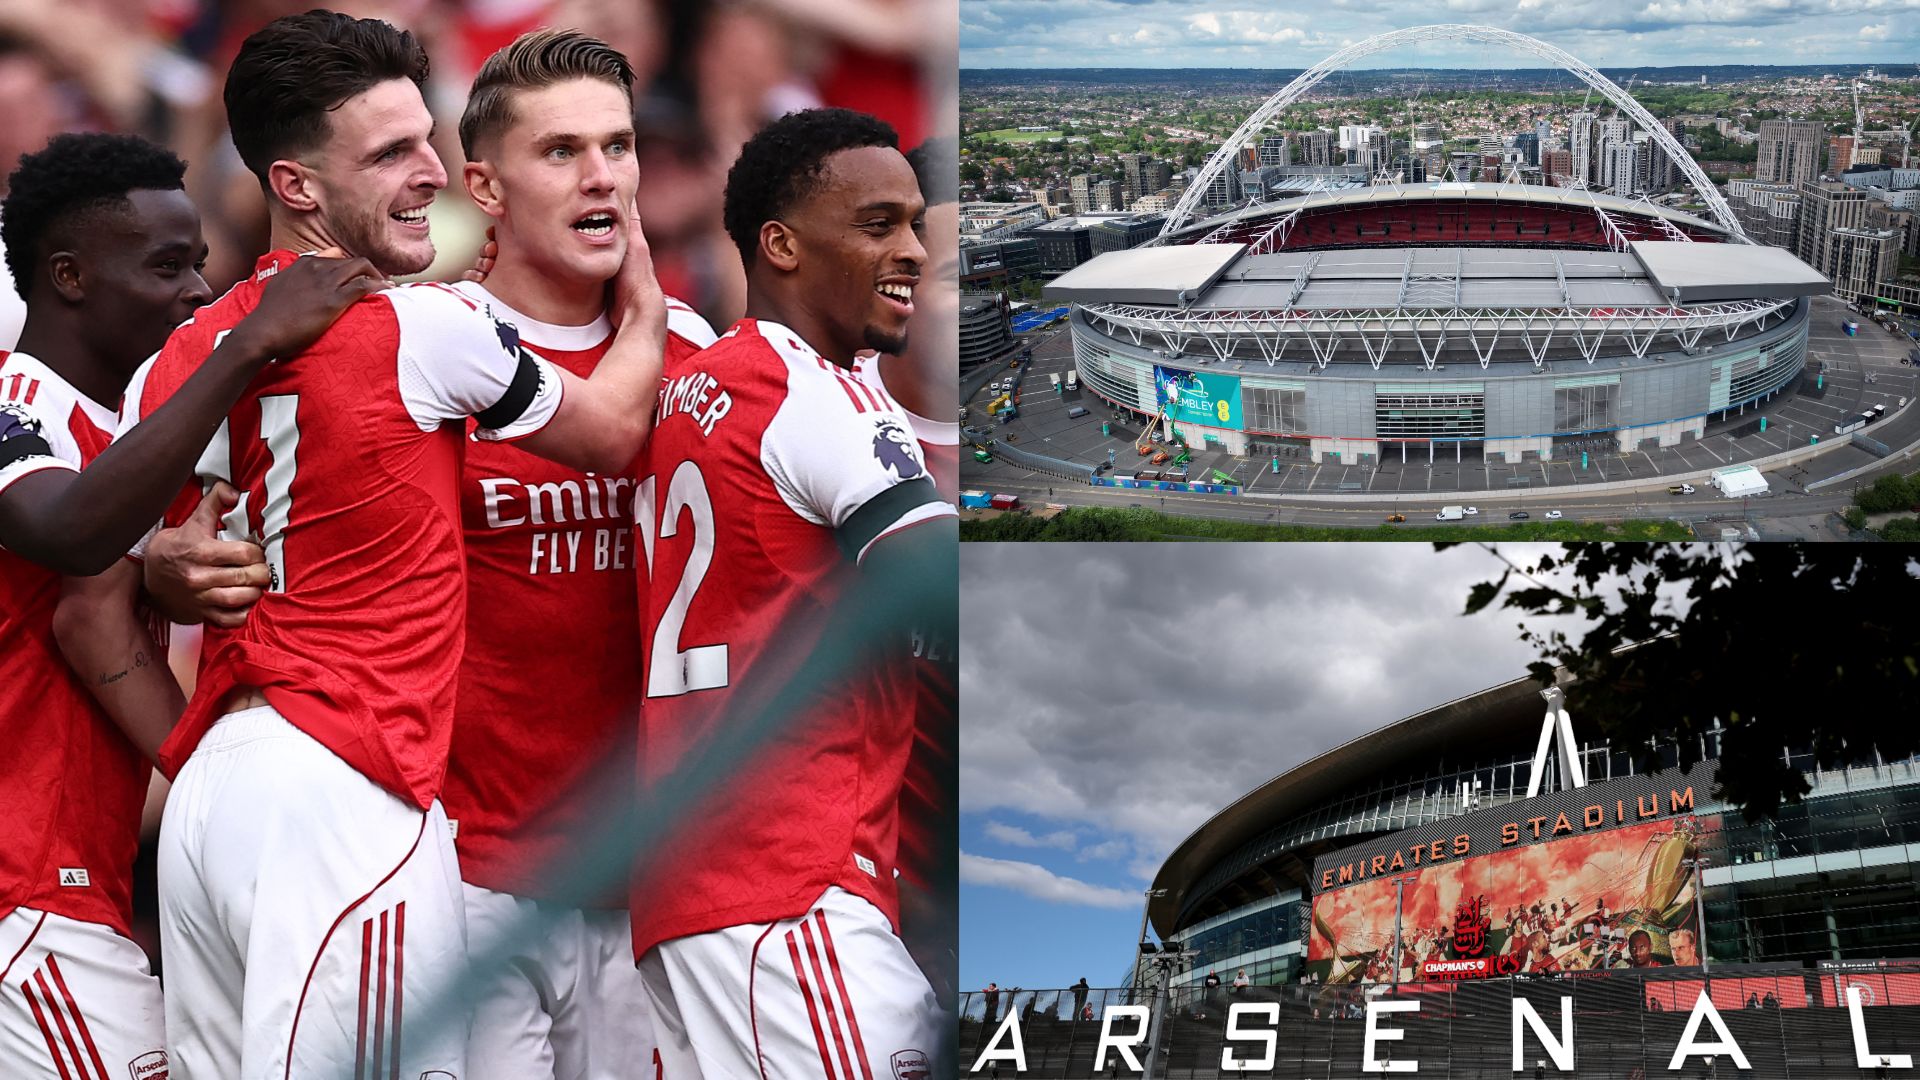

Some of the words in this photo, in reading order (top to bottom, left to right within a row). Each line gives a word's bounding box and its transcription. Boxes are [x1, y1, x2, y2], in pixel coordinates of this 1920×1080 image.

[478, 472, 636, 529] Emir
[529, 530, 582, 575] FLY
[594, 528, 637, 571] BE
[633, 459, 729, 698] 12
[1321, 833, 1471, 889] EMIRATES
[1501, 786, 1695, 846] STADIUM
[1425, 961, 1476, 973] CHAPMAN'S
[970, 987, 1914, 1072] ARSENAL
